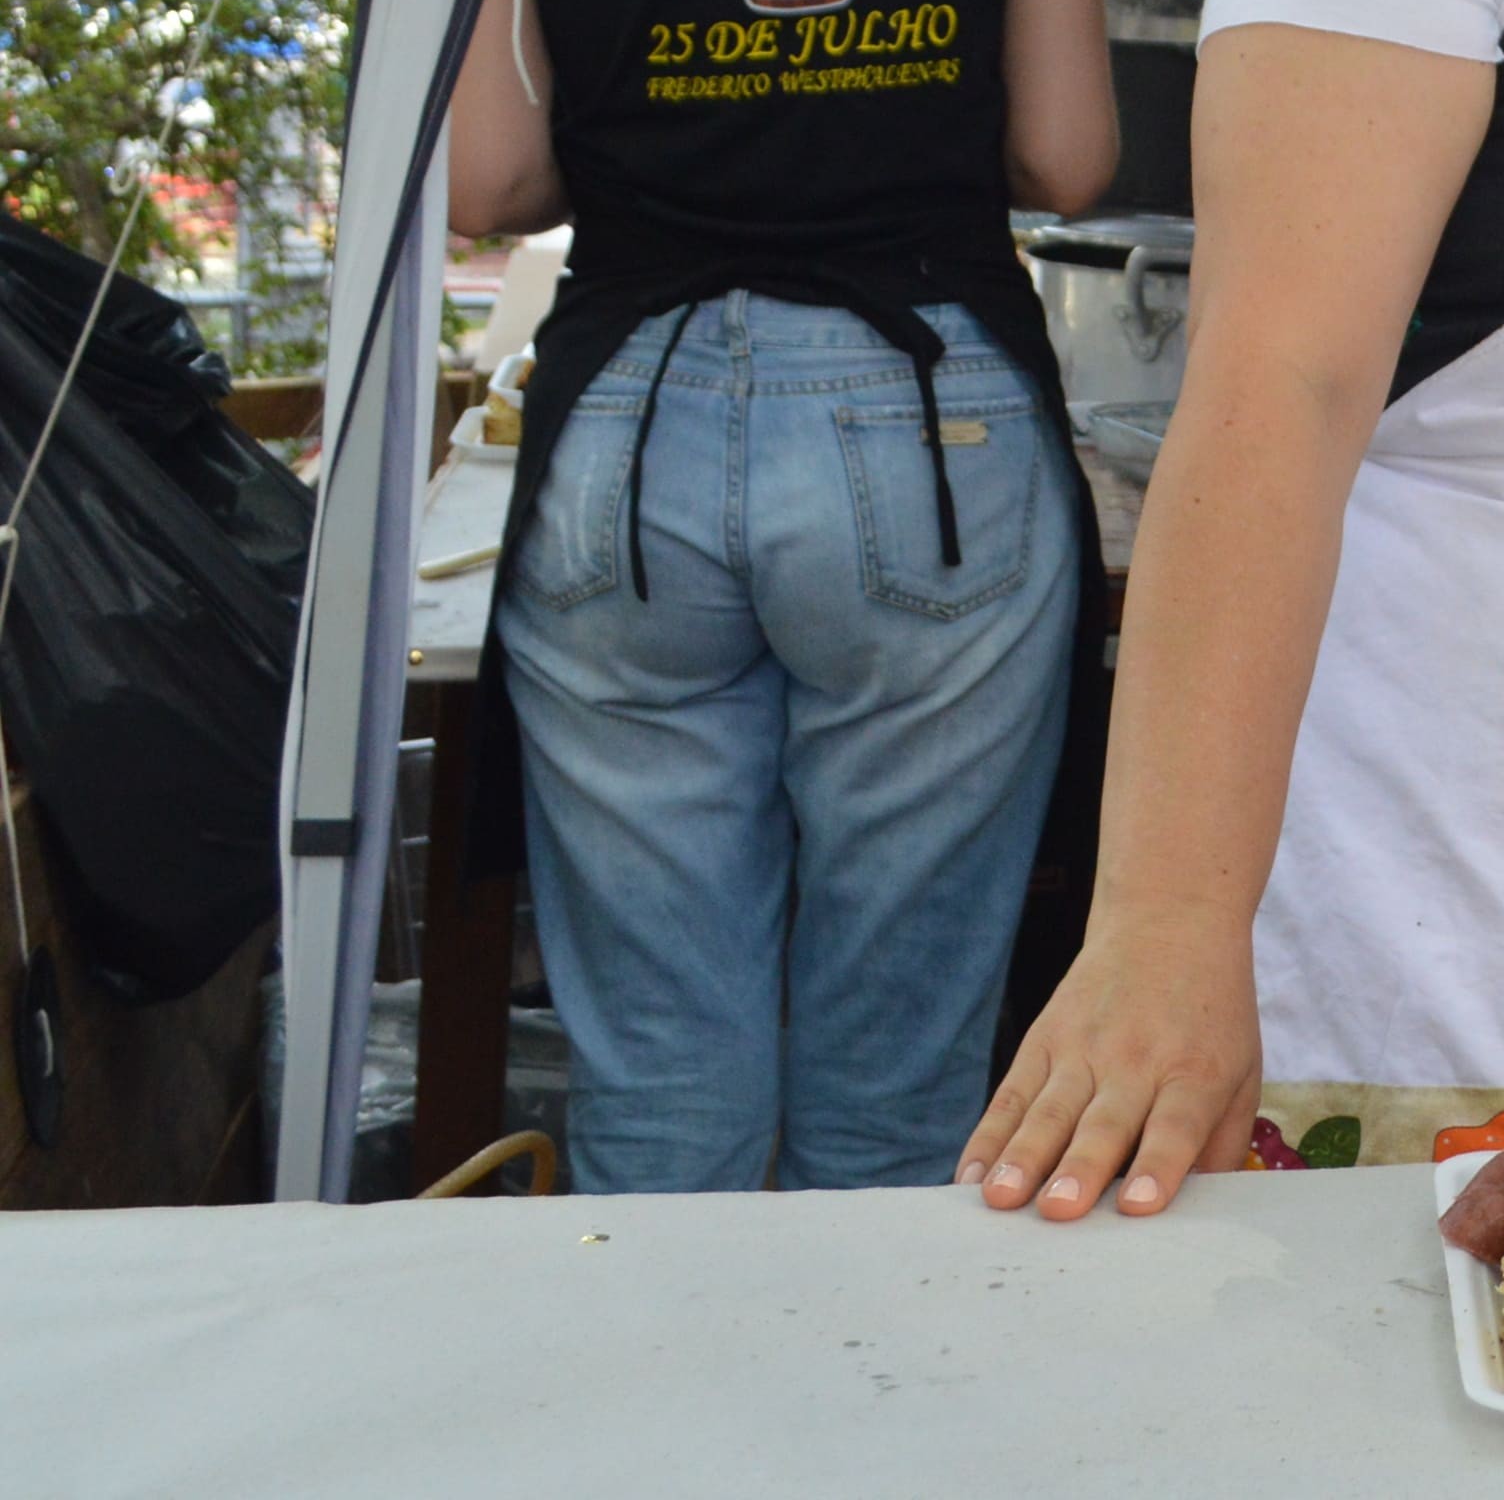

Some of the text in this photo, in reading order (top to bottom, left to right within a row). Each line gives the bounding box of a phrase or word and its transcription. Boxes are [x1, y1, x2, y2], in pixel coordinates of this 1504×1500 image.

[647, 3, 959, 66] 25 DE JULHO
[647, 73, 772, 102] FREDERICO
